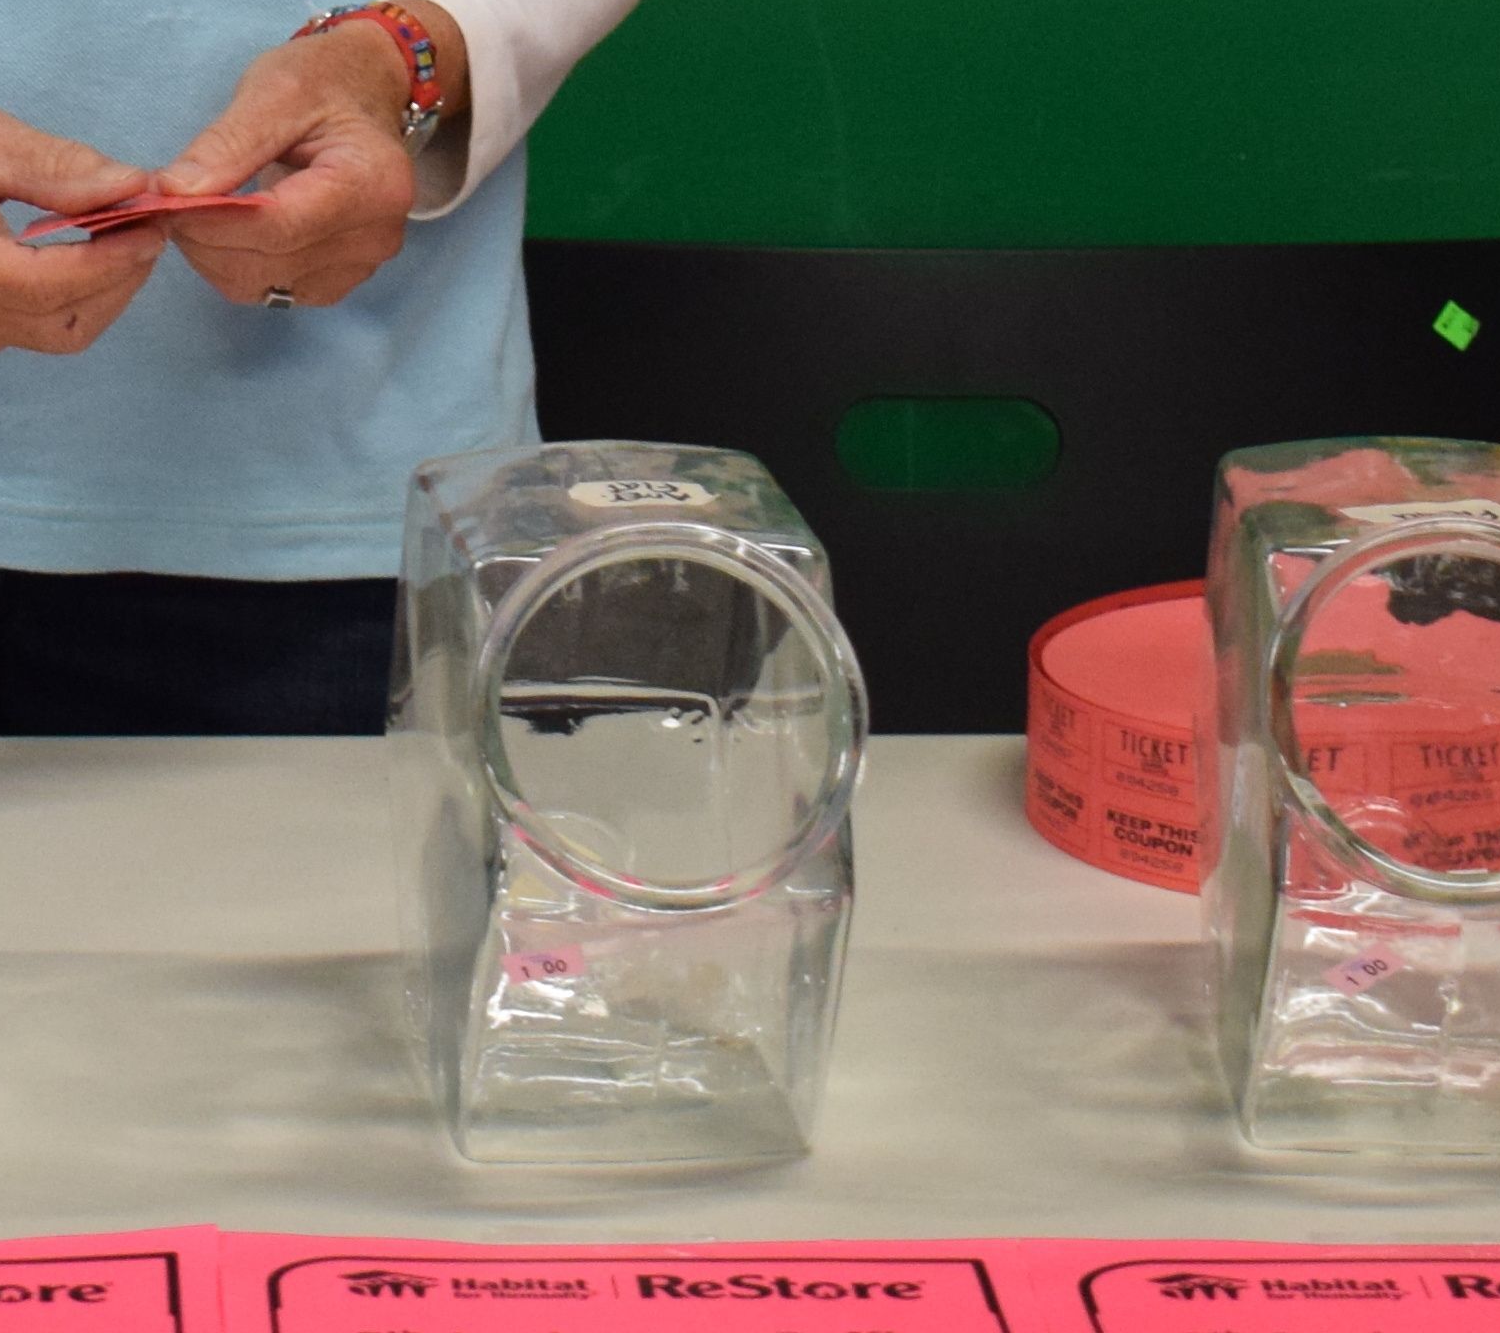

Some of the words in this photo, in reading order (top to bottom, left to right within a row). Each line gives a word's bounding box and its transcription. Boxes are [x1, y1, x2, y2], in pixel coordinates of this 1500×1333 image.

[1120, 729, 1189, 766] TICKET
[1107, 808, 1153, 831] KEEP
[1158, 822, 1200, 844] THIS
[1114, 826, 1193, 857] COUPON
[450, 1277, 589, 1291] Habitat
[635, 1273, 924, 1301] ReStore
[1260, 1278, 1400, 1292] Habitat
